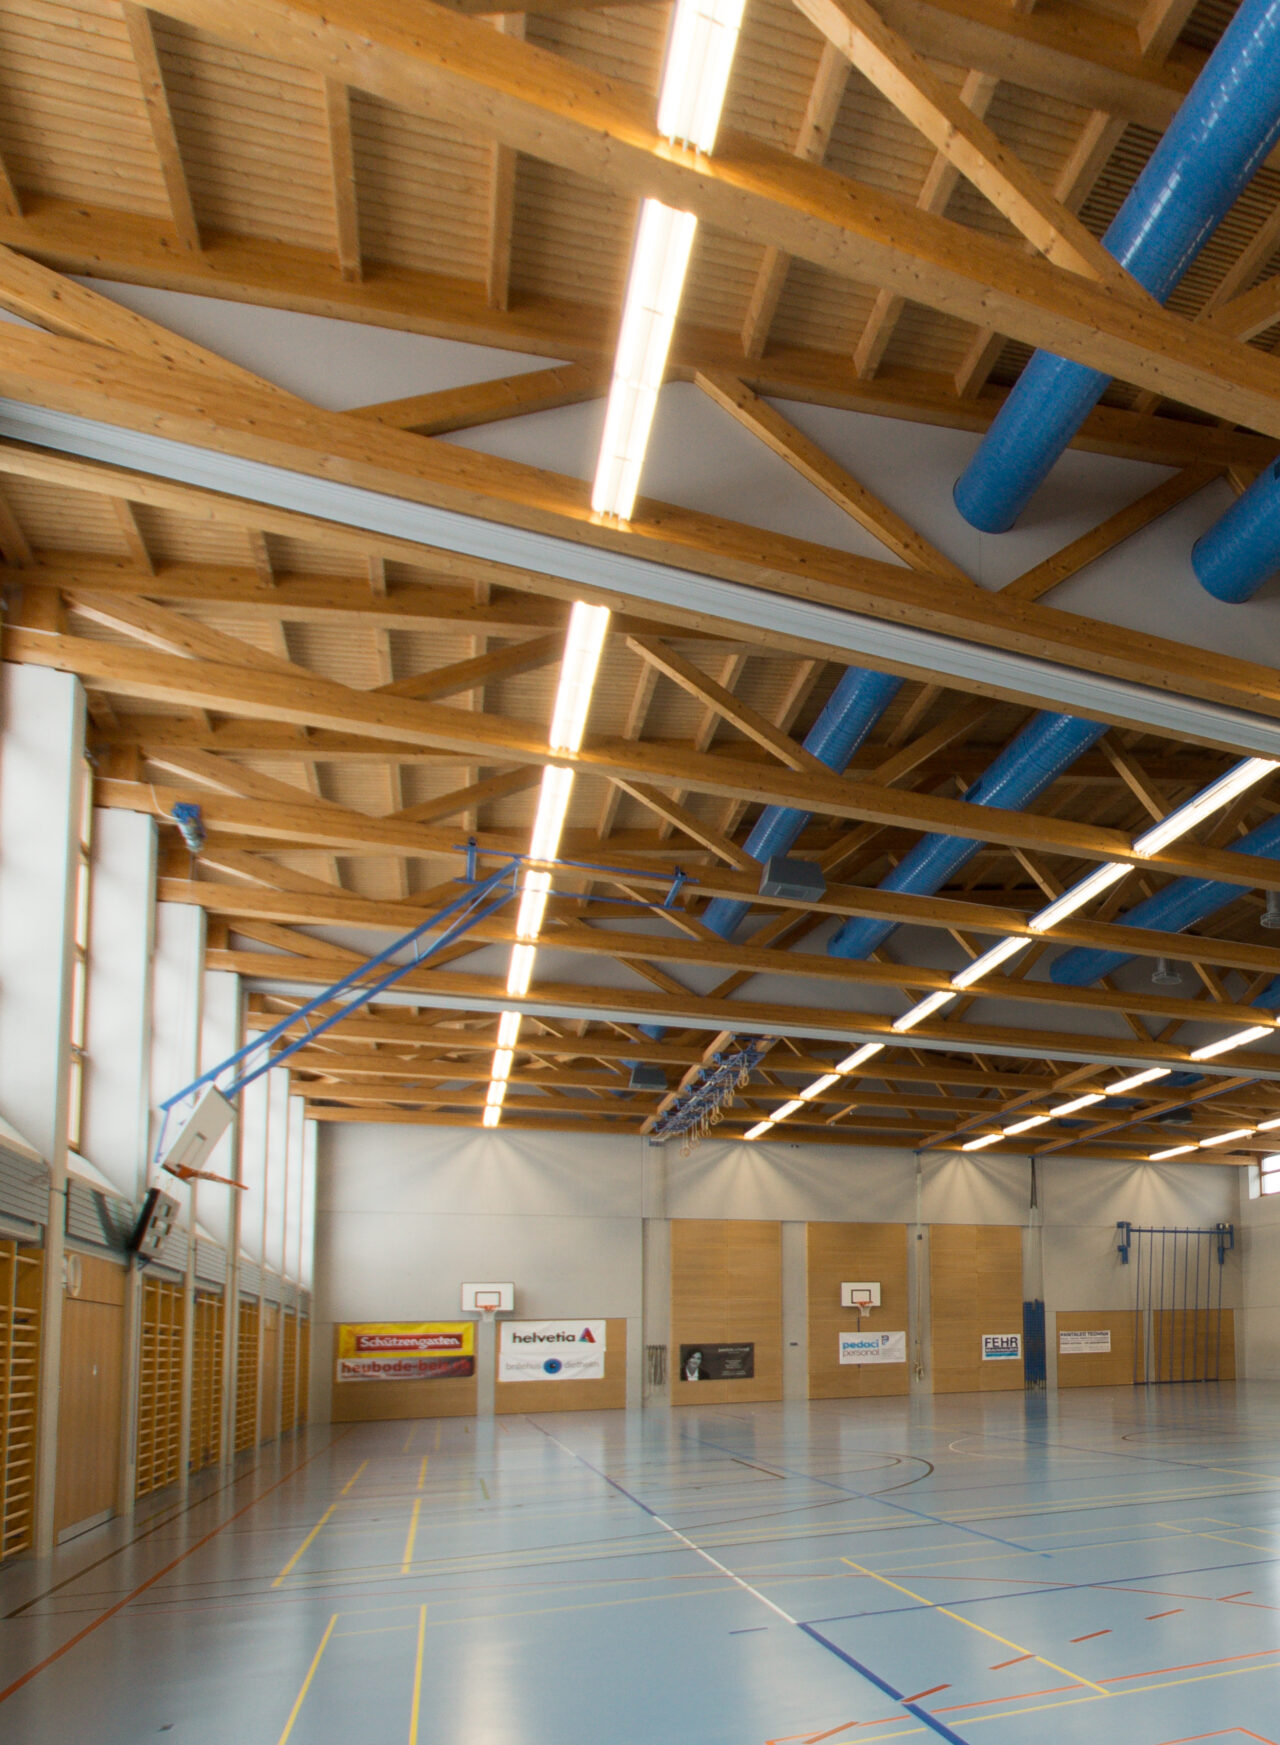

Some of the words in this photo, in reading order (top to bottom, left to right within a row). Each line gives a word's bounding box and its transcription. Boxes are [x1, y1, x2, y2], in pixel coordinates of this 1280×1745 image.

[360, 1335, 460, 1350] Schützengarten
[512, 1331, 576, 1344] helvetia
[842, 1338, 879, 1350] pedaci
[984, 1336, 1019, 1349] FEHR
